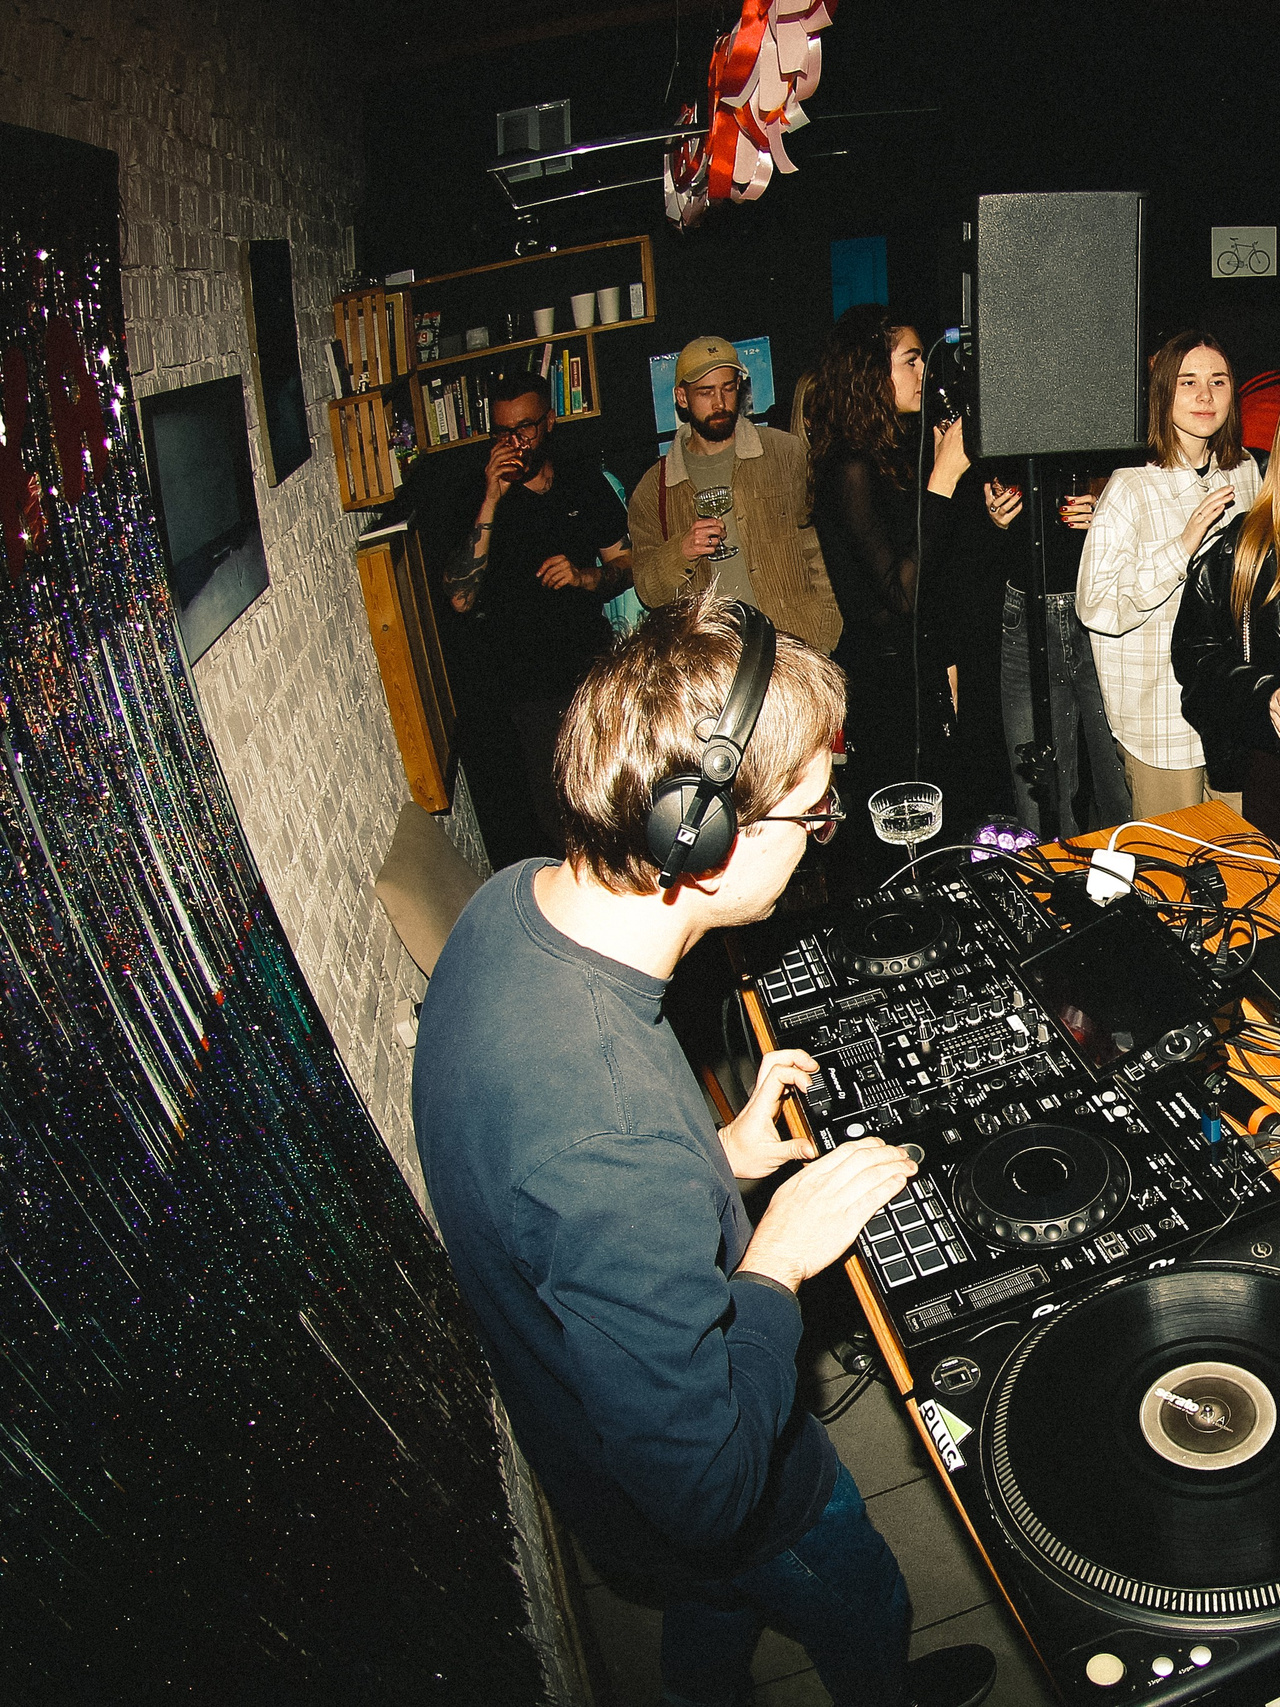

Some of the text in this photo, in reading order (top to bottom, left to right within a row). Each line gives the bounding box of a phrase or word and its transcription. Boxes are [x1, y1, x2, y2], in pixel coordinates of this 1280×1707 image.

[744, 348, 760, 356] 12+
[828, 1067, 842, 1091] Pioneer
[1155, 1388, 1200, 1413] serato
[922, 1405, 957, 1470] PLUS
[1178, 1665, 1195, 1675] 45rpm
